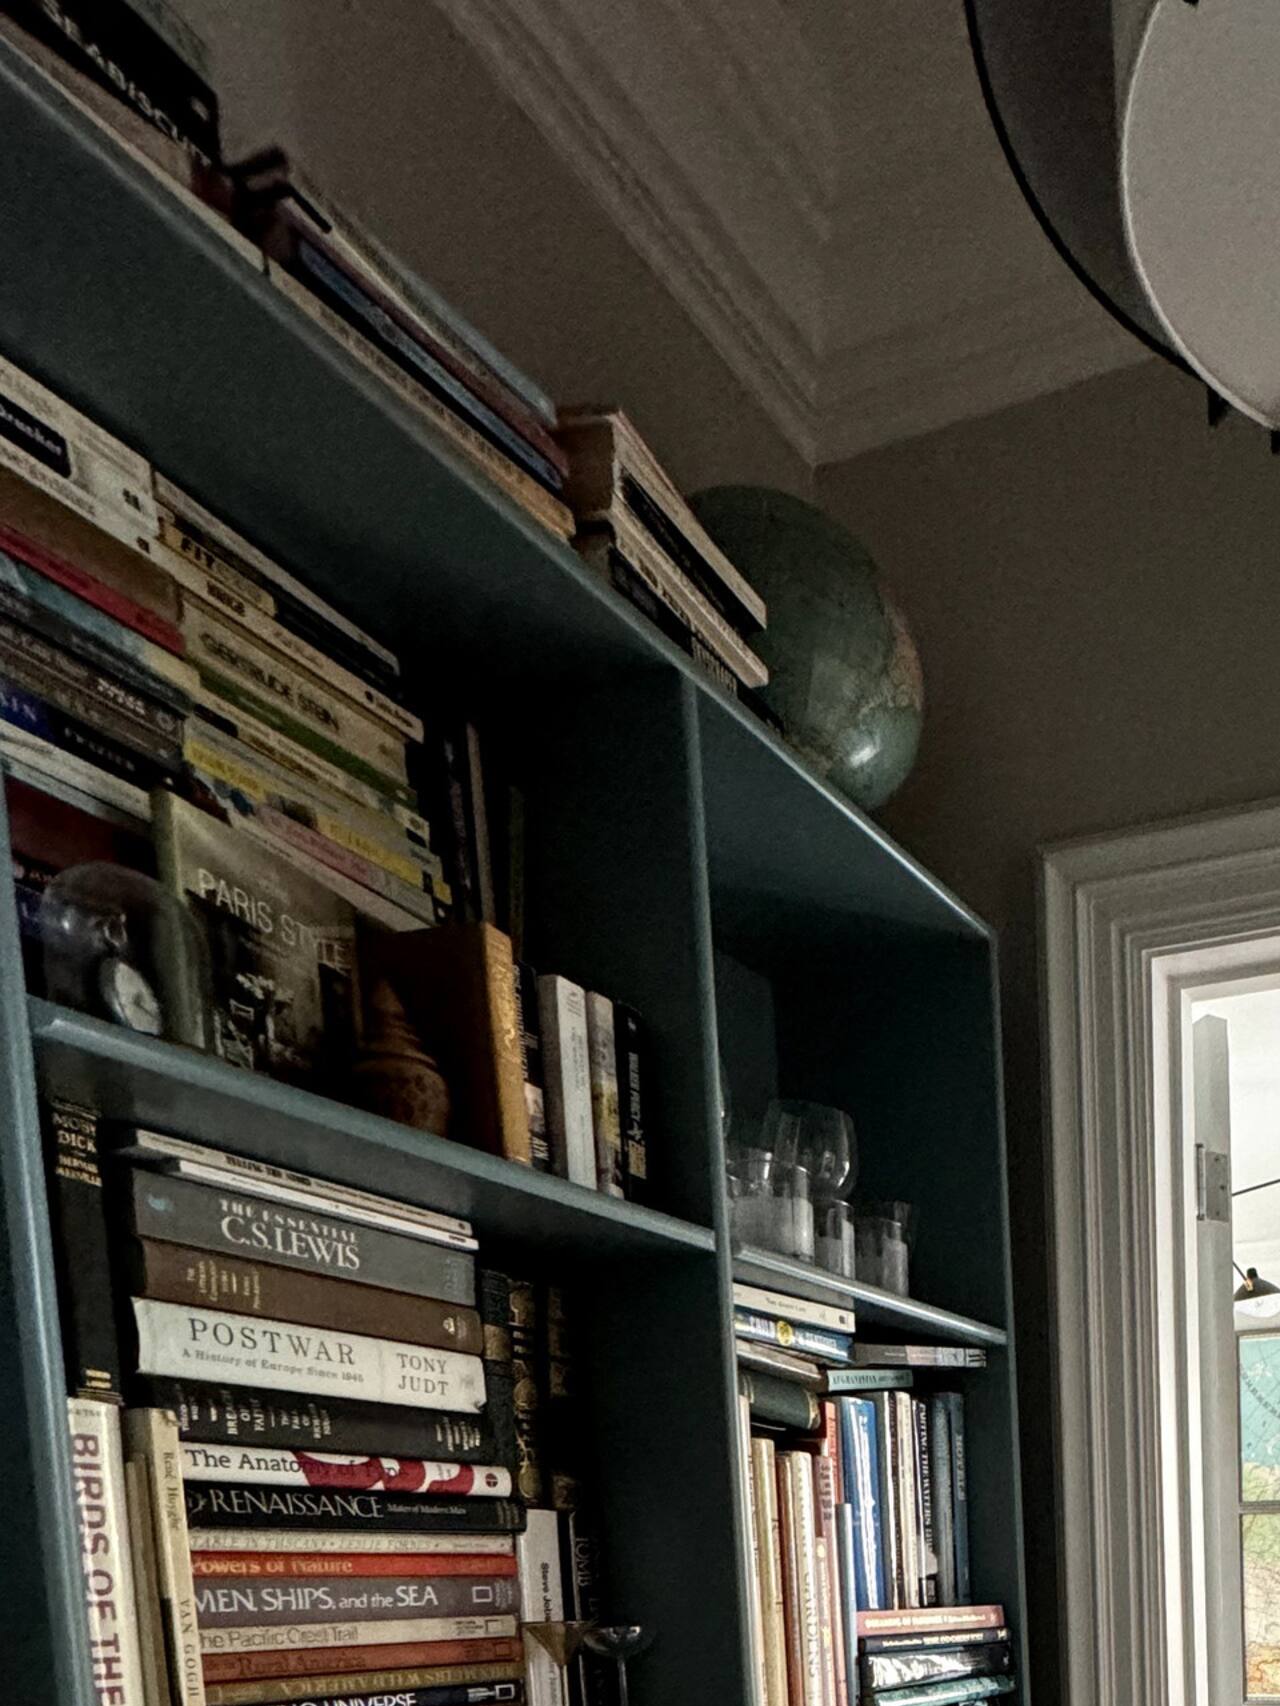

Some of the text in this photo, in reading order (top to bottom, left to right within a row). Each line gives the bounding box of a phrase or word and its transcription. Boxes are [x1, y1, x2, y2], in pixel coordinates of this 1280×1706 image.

[199, 868, 273, 934] PARIS
[52, 1111, 97, 1137] MOBY
[57, 1130, 98, 1154] DICK
[218, 1199, 257, 1220] THE
[188, 1318, 356, 1366] POSTWAR
[181, 1348, 191, 1359] A
[195, 1349, 242, 1368] History
[245, 1356, 257, 1368] of
[261, 1359, 302, 1376] Europe
[306, 1365, 339, 1380] Since
[396, 1352, 449, 1375] TONY
[397, 1374, 449, 1397] JUDT
[187, 1449, 231, 1469] The
[72, 1434, 108, 1560] BIRDS
[210, 1489, 385, 1519] RENAISSANCE
[540, 1562, 550, 1592] Steve
[88, 1569, 117, 1628] OF
[338, 1588, 368, 1609] and
[370, 1590, 394, 1608] the
[397, 1586, 439, 1607] SEA
[180, 1599, 201, 1698] VAN GOGH
[200, 1630, 224, 1649] he
[229, 1628, 286, 1649] Pacific
[90, 1630, 126, 1706] THE
